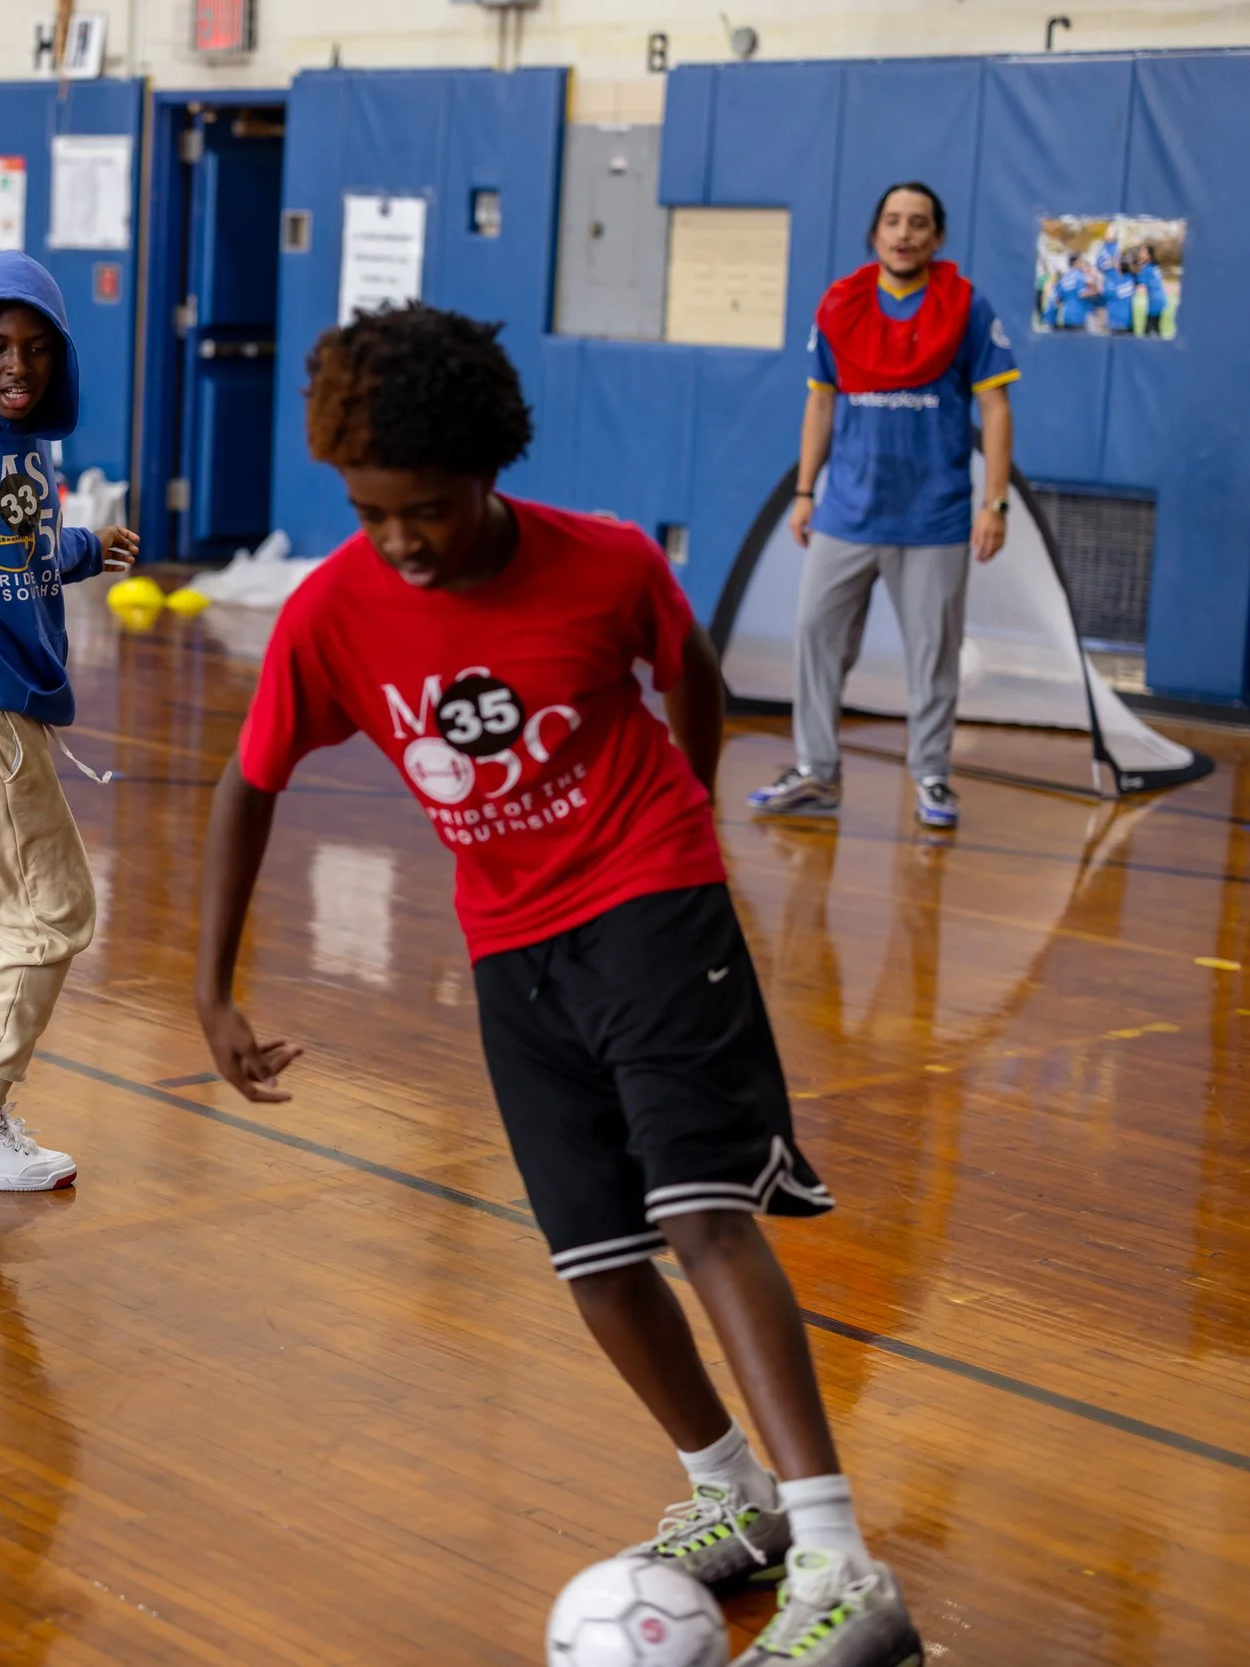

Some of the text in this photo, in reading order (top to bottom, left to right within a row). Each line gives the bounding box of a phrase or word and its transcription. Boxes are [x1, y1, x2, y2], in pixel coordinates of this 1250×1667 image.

[0, 484, 38, 525] 33
[440, 688, 521, 745] 35
[427, 802, 498, 826] PRIDE
[444, 787, 587, 845] SOUTHSIDE
